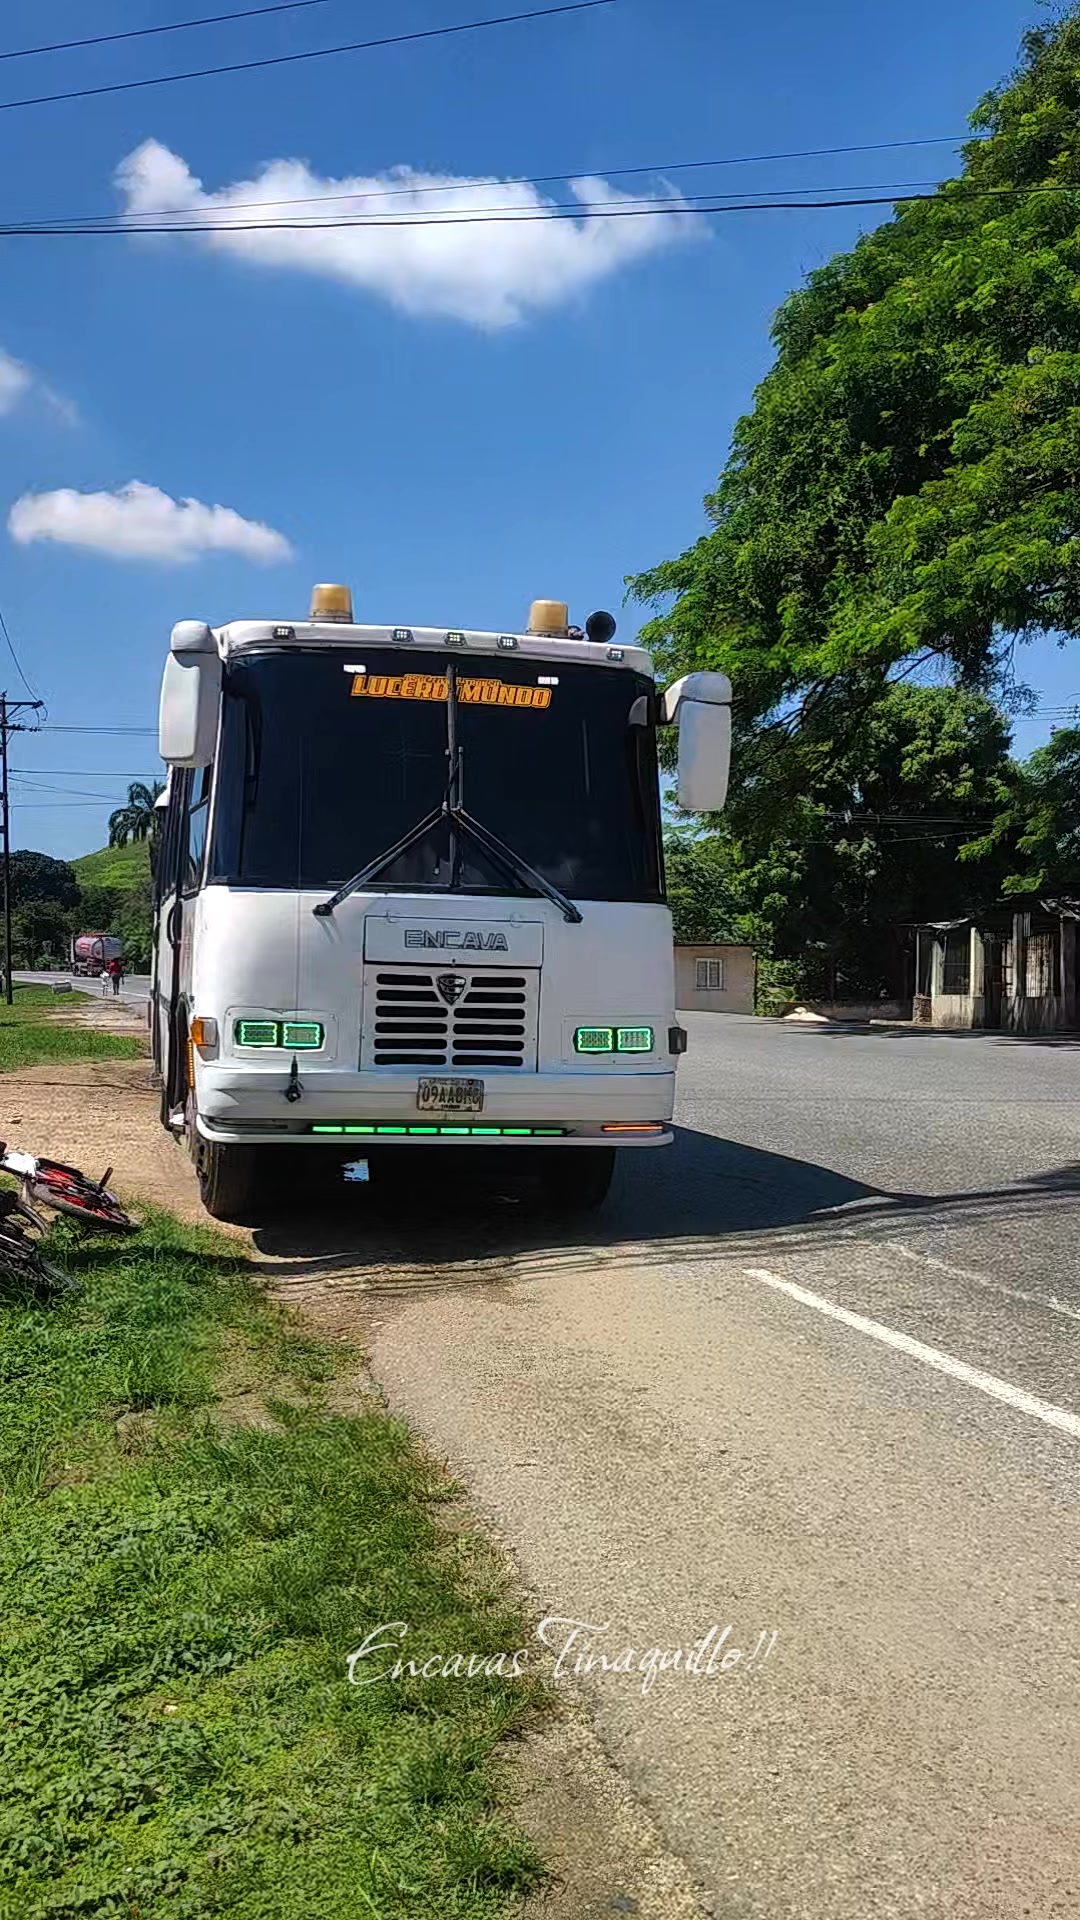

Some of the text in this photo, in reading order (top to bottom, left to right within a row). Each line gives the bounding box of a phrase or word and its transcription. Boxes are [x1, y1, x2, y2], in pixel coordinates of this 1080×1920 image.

[351, 675, 449, 701] LUCERO
[457, 684, 552, 708] MUNDO
[404, 929, 508, 951] ENCAVA
